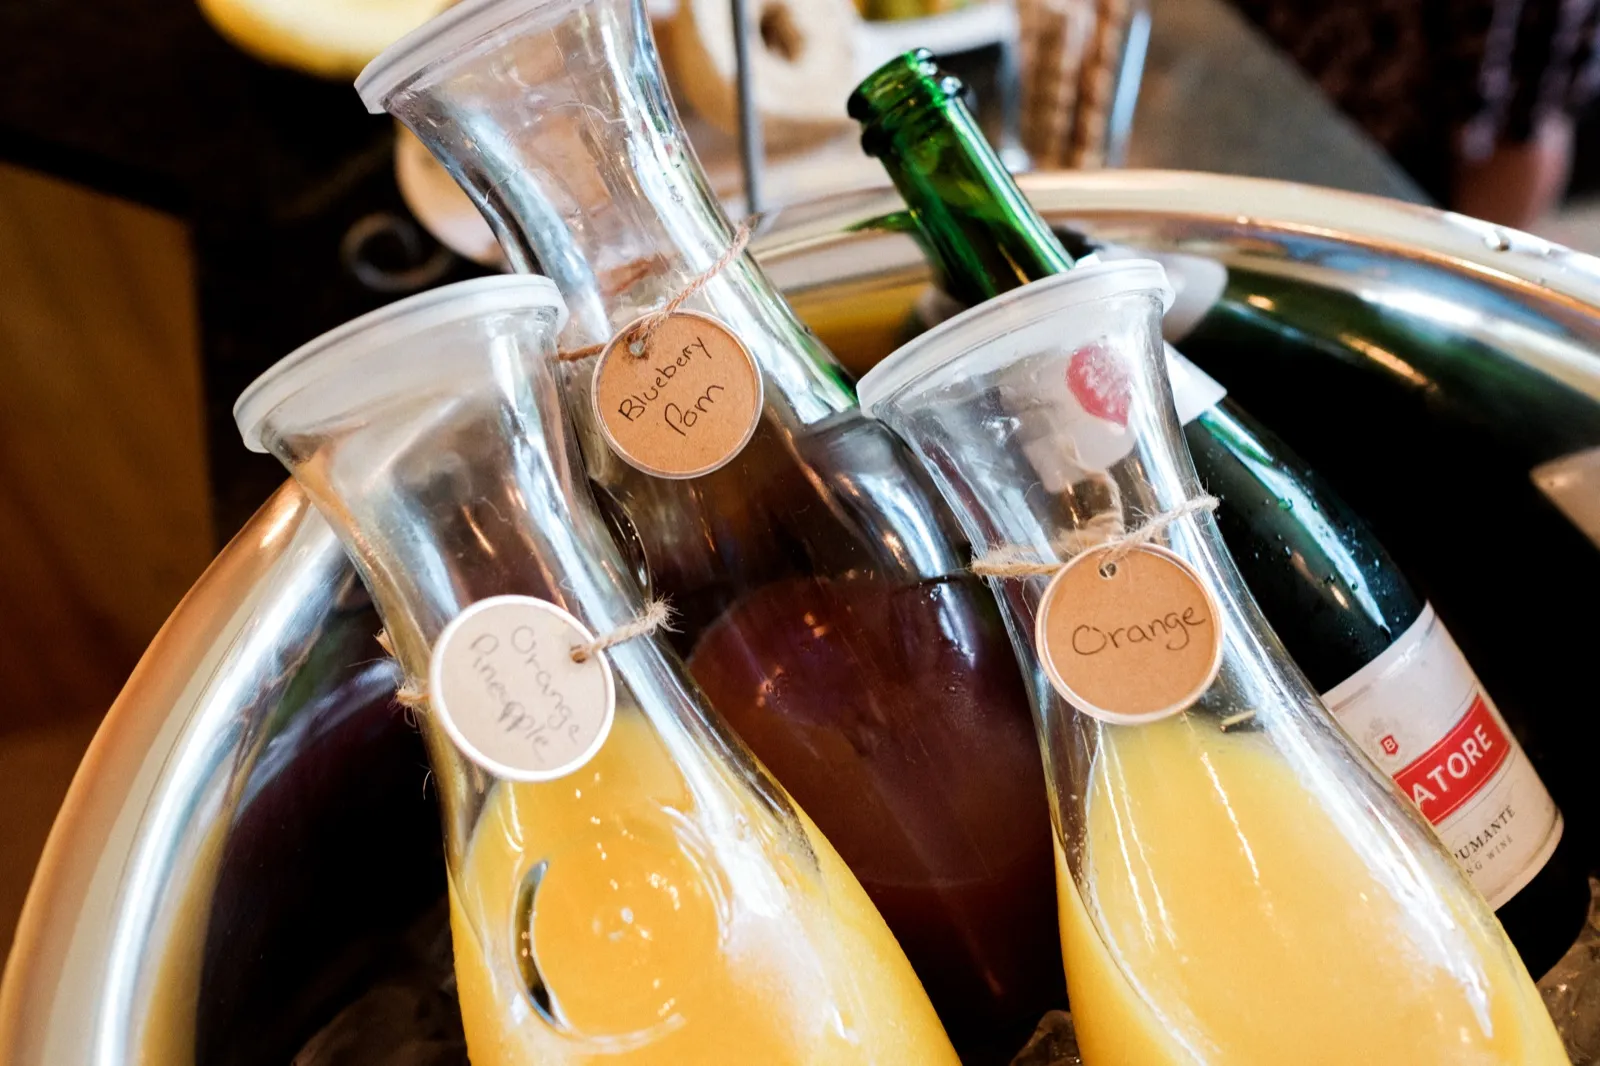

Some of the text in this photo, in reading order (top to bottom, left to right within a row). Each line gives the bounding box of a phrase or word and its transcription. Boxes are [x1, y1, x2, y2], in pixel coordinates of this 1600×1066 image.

[618, 337, 713, 422] Blueberry
[664, 384, 725, 437] Pom
[1072, 606, 1207, 656] Orange
[469, 633, 549, 763] Pineapple
[510, 625, 580, 744] Orange
[1383, 738, 1396, 752] B
[1413, 724, 1493, 808] ATORE
[1454, 804, 1516, 860] UMANTE
